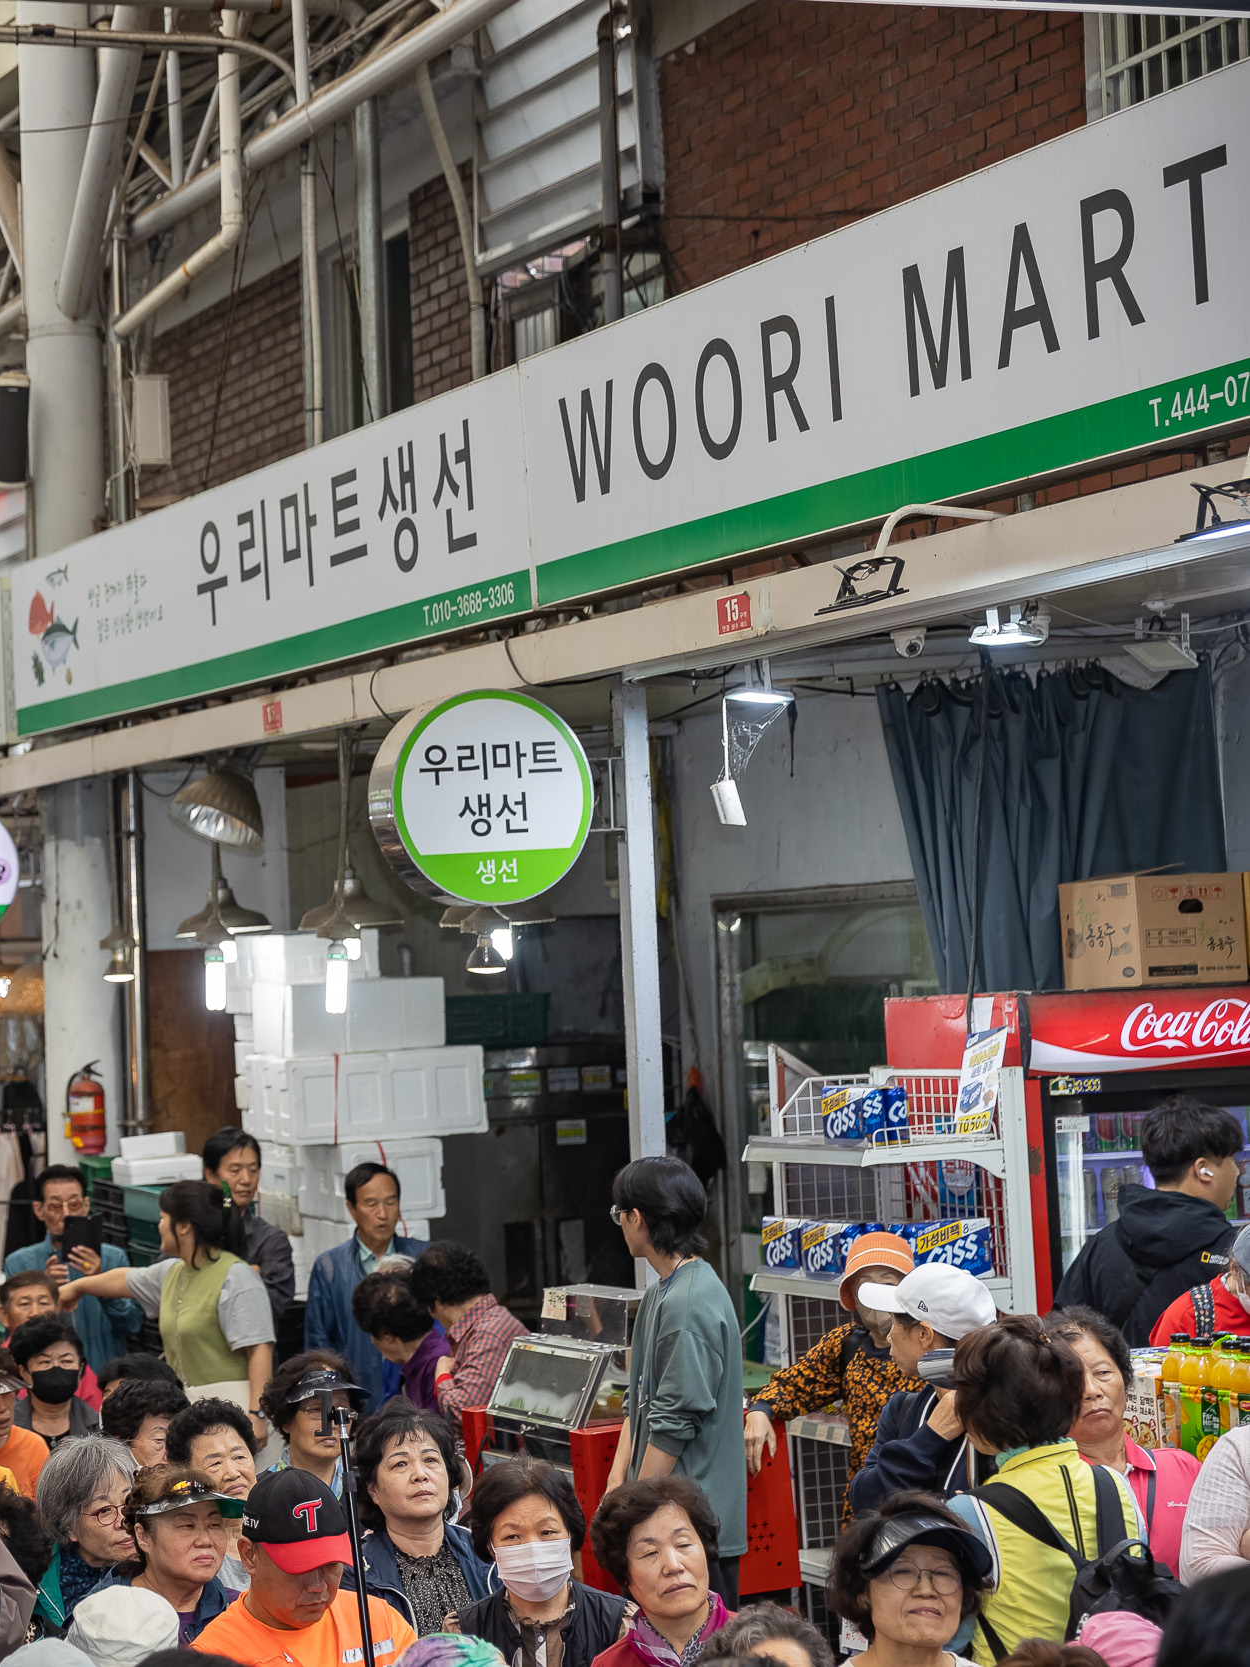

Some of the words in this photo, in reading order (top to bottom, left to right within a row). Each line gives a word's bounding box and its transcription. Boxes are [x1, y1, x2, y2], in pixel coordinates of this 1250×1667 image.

[558, 295, 843, 503] WOORI
[901, 144, 1228, 398] MART
[197, 418, 477, 626] 우리마트생선
[422, 581, 515, 626] T.010-3668-3306
[725, 598, 739, 622] 15
[419, 740, 563, 786] 우리마트
[458, 791, 529, 837] 생선
[476, 858, 518, 885] 생선
[1086, 923, 1116, 963] 동동주
[1207, 936, 1237, 960] 동동주
[920, 1224, 960, 1250] 가성비팩
[963, 1223, 969, 1234] 8
[293, 1498, 322, 1532] T
